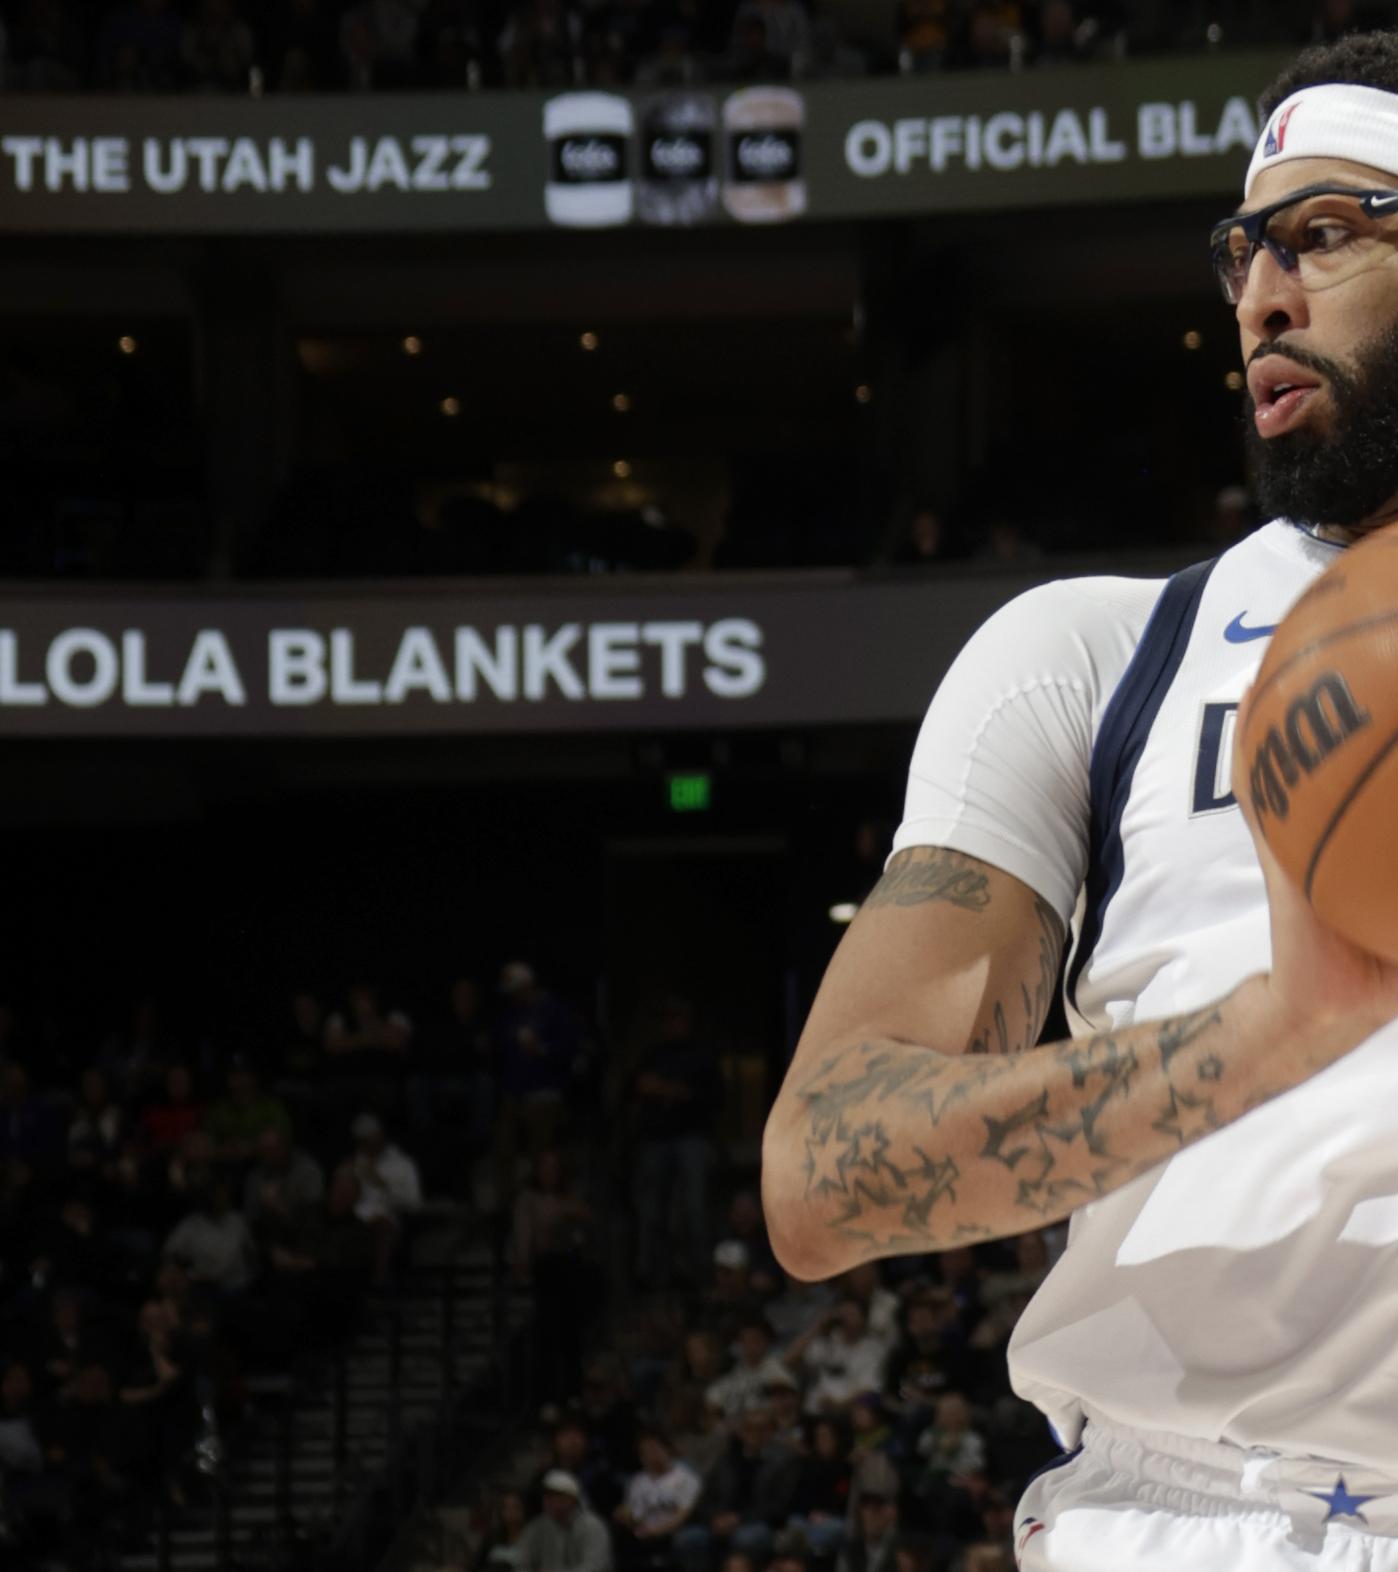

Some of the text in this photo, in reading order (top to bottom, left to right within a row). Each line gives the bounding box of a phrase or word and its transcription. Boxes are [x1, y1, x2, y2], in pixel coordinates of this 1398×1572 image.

[2, 135, 490, 193] THE UTAH JAZZ
[844, 108, 1127, 177] OFFICIAL
[0, 619, 766, 707] LOLA BLANKETS
